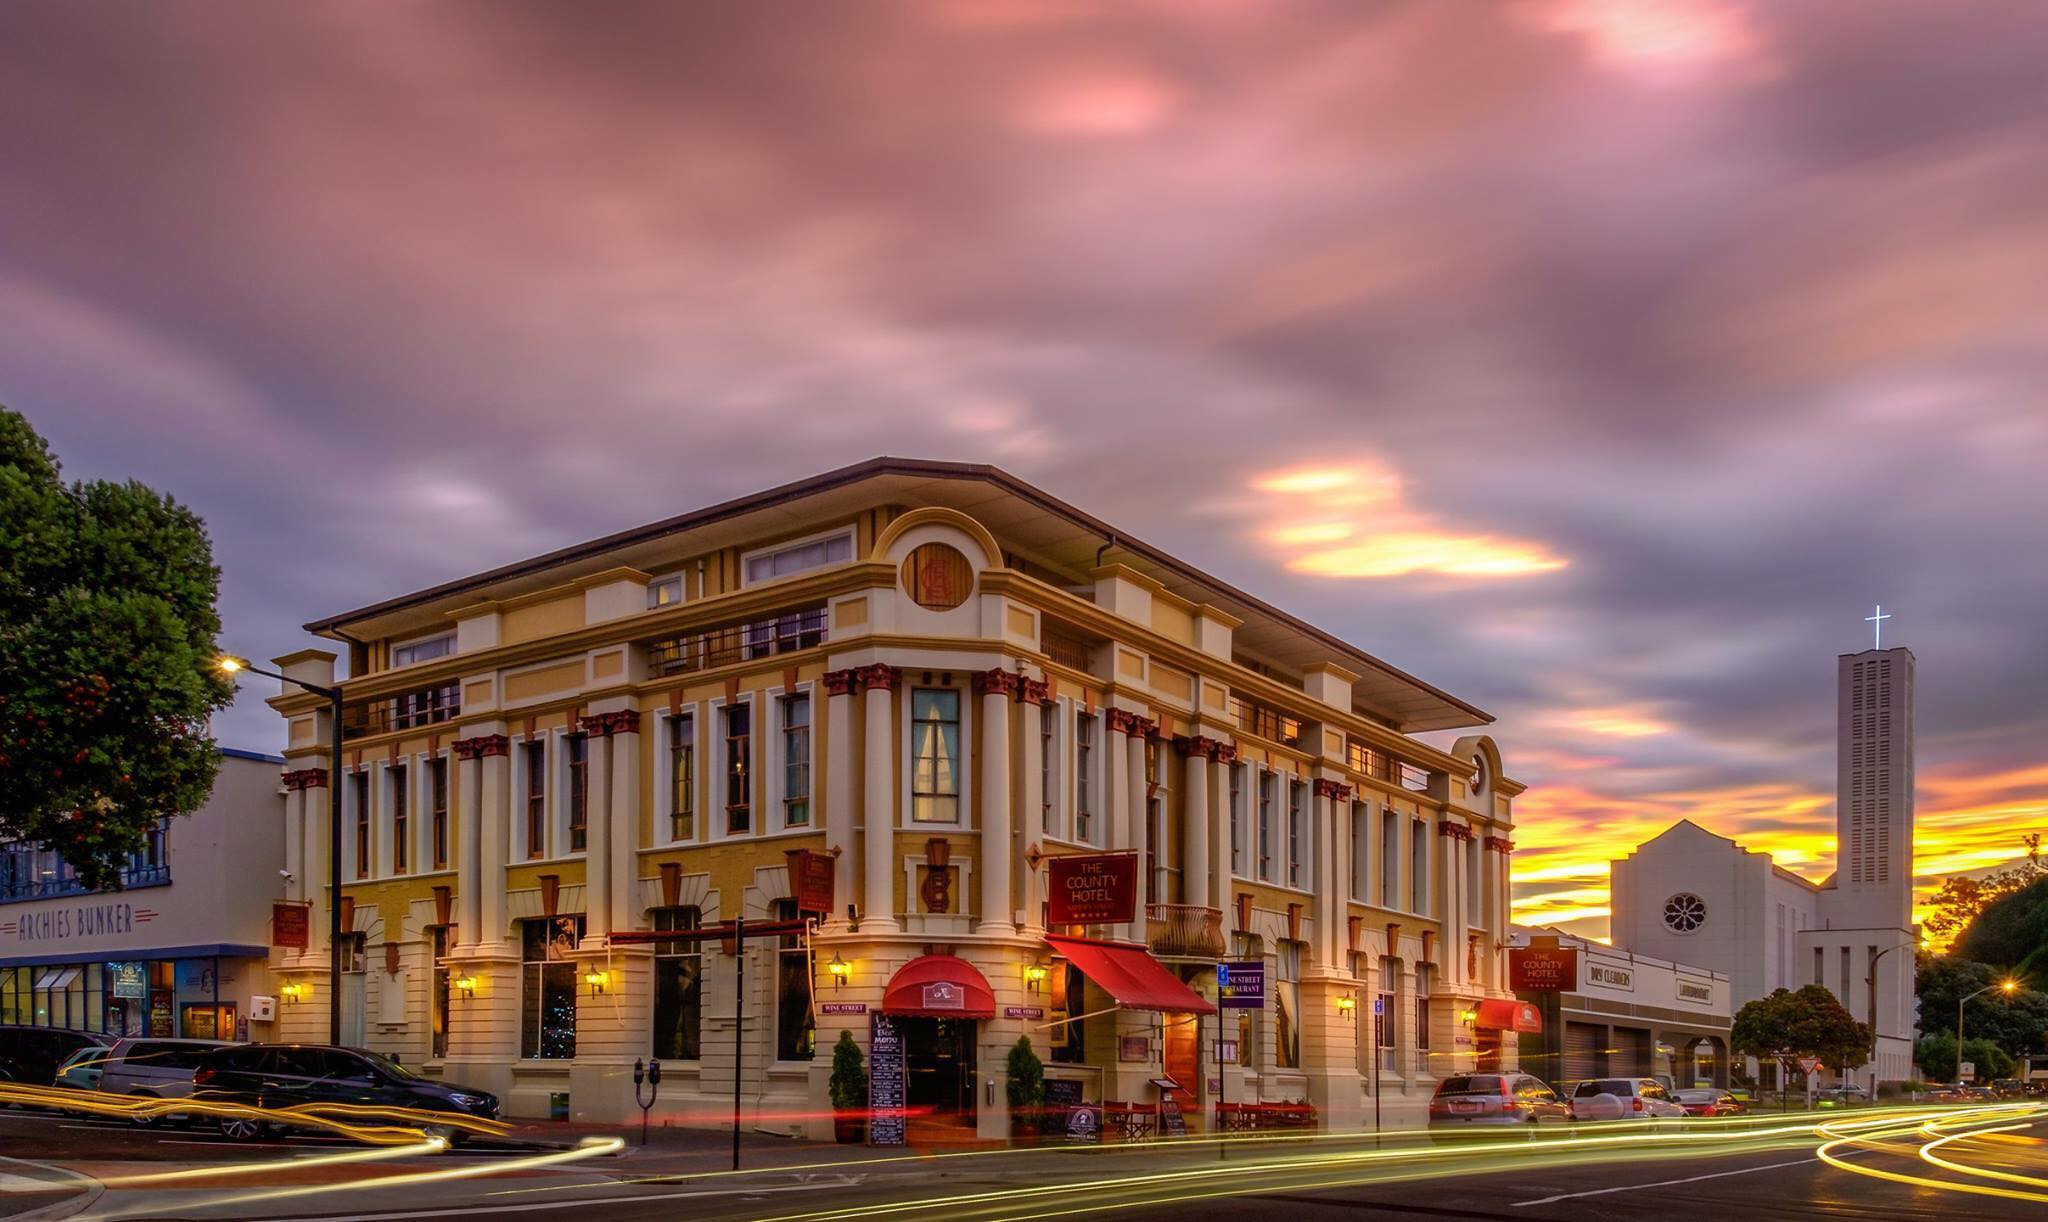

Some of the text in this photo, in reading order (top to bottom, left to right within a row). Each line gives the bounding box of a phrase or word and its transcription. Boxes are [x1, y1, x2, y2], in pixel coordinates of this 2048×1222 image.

[1081, 863, 1103, 873] THE
[1066, 875, 1118, 889] COUNTY
[1072, 889, 1112, 902] HOTEL
[19, 903, 131, 940] ARCHIES BUNKER
[1523, 960, 1563, 969] COUNTY
[1238, 976, 1260, 984] STREET
